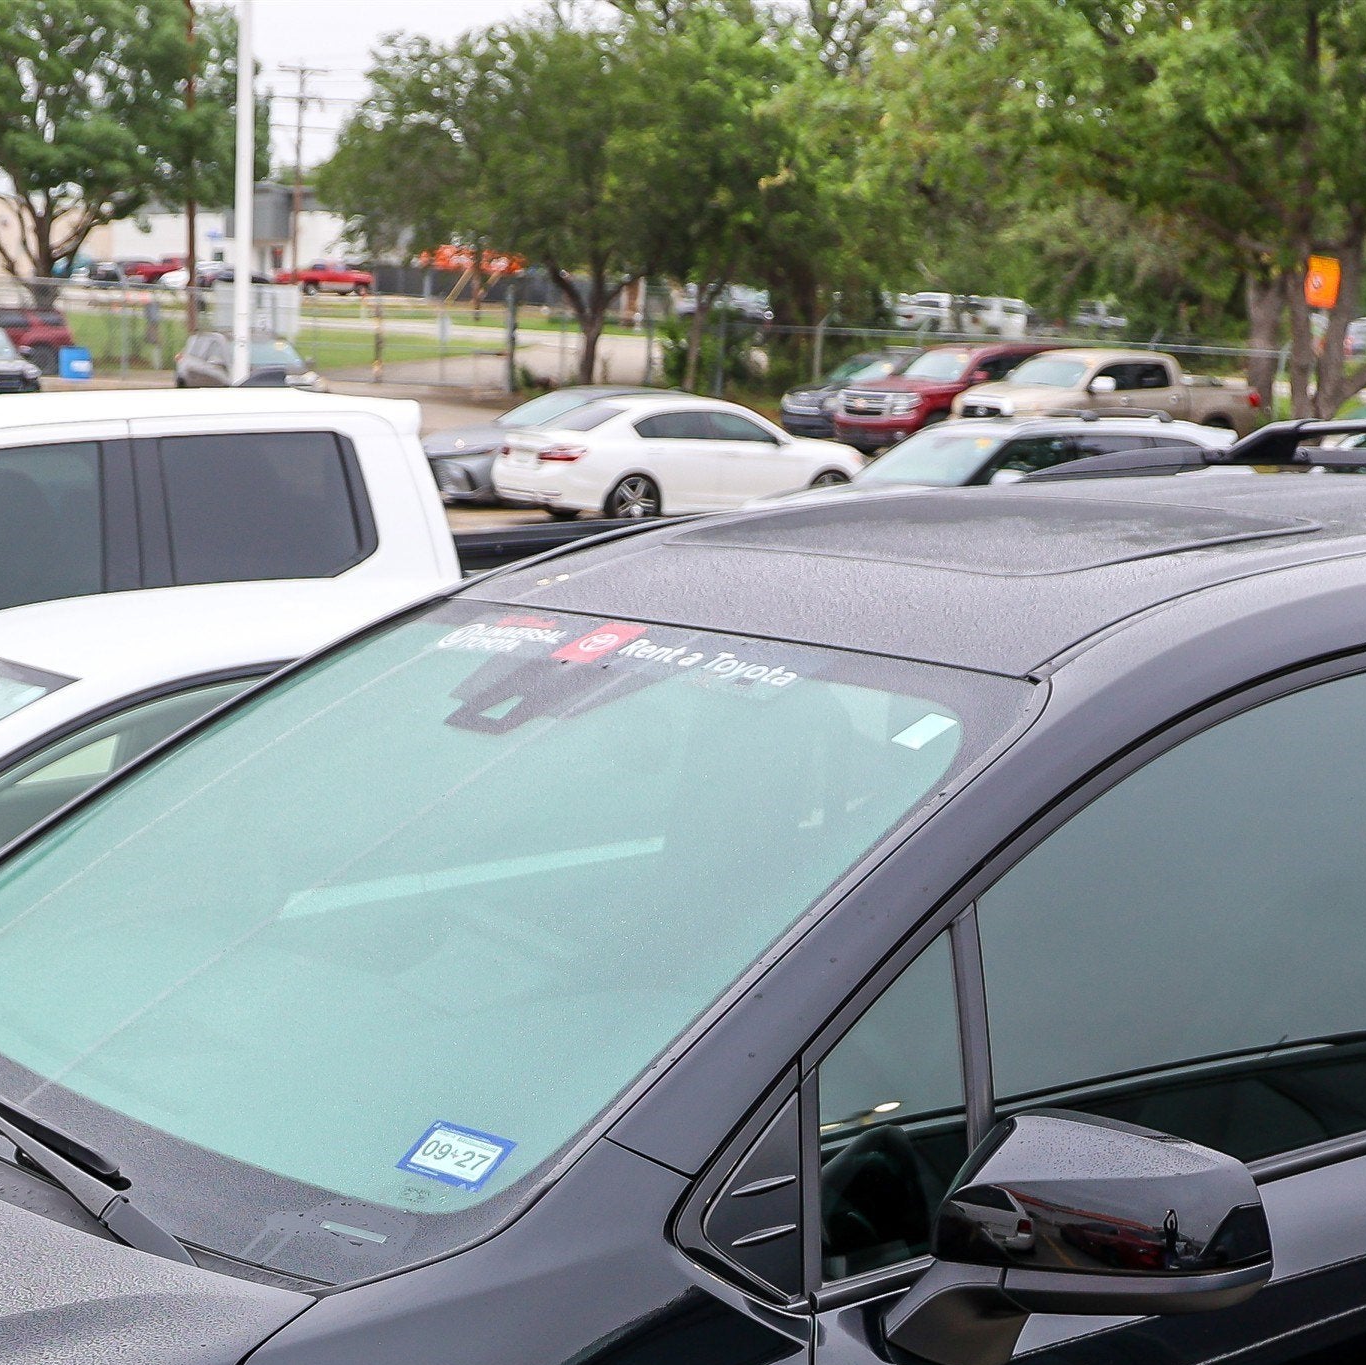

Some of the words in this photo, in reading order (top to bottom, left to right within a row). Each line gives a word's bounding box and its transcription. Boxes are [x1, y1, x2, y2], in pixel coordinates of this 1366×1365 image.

[618, 638, 687, 663] Rent
[678, 652, 704, 667] a
[702, 651, 798, 687] Toyota
